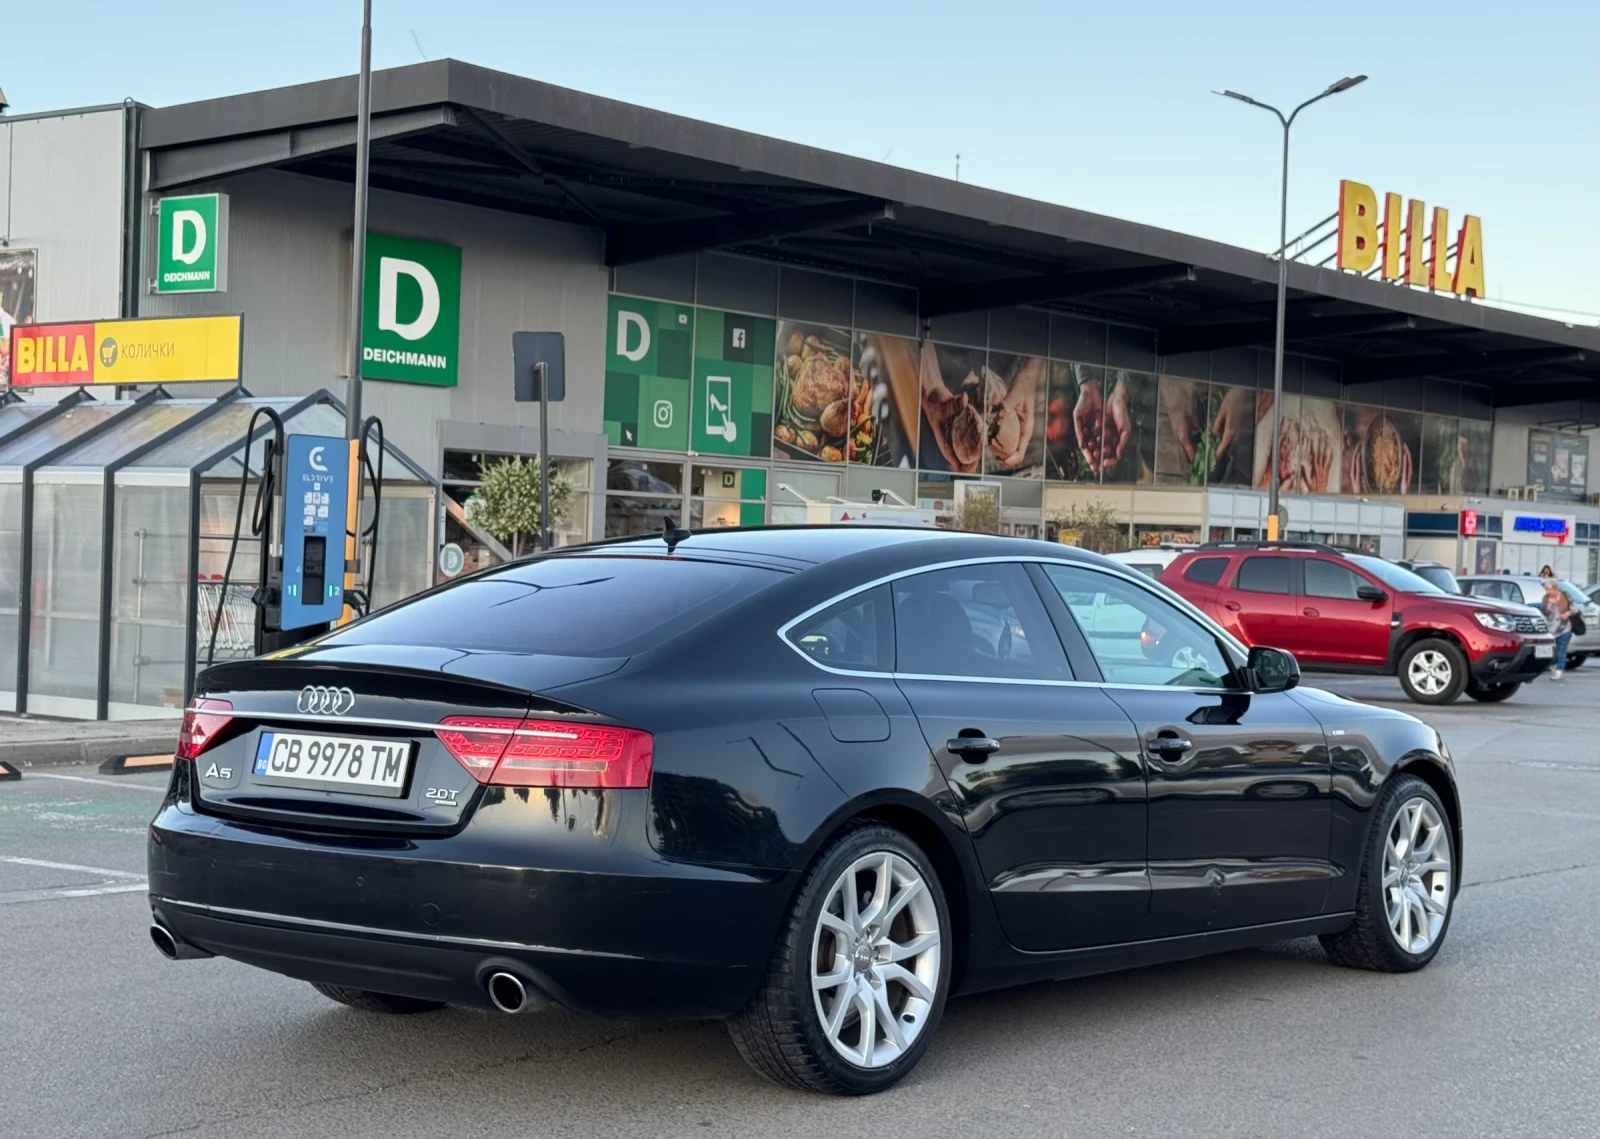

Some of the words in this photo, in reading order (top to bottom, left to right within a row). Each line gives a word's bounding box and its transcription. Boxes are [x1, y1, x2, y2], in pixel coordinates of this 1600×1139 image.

[172, 210, 207, 265] D
[1337, 179, 1485, 299] BILLA
[164, 270, 210, 283] DEICHMANN
[378, 256, 440, 341] D
[17, 335, 89, 374] BILLA
[121, 342, 175, 359] КОЛИЧКИ
[616, 310, 651, 362] D
[363, 347, 446, 369] DEICHMANN
[205, 762, 233, 779] A5
[257, 759, 267, 770] BG
[271, 738, 303, 773] CB
[306, 741, 364, 778] 9978
[371, 745, 404, 782] TM
